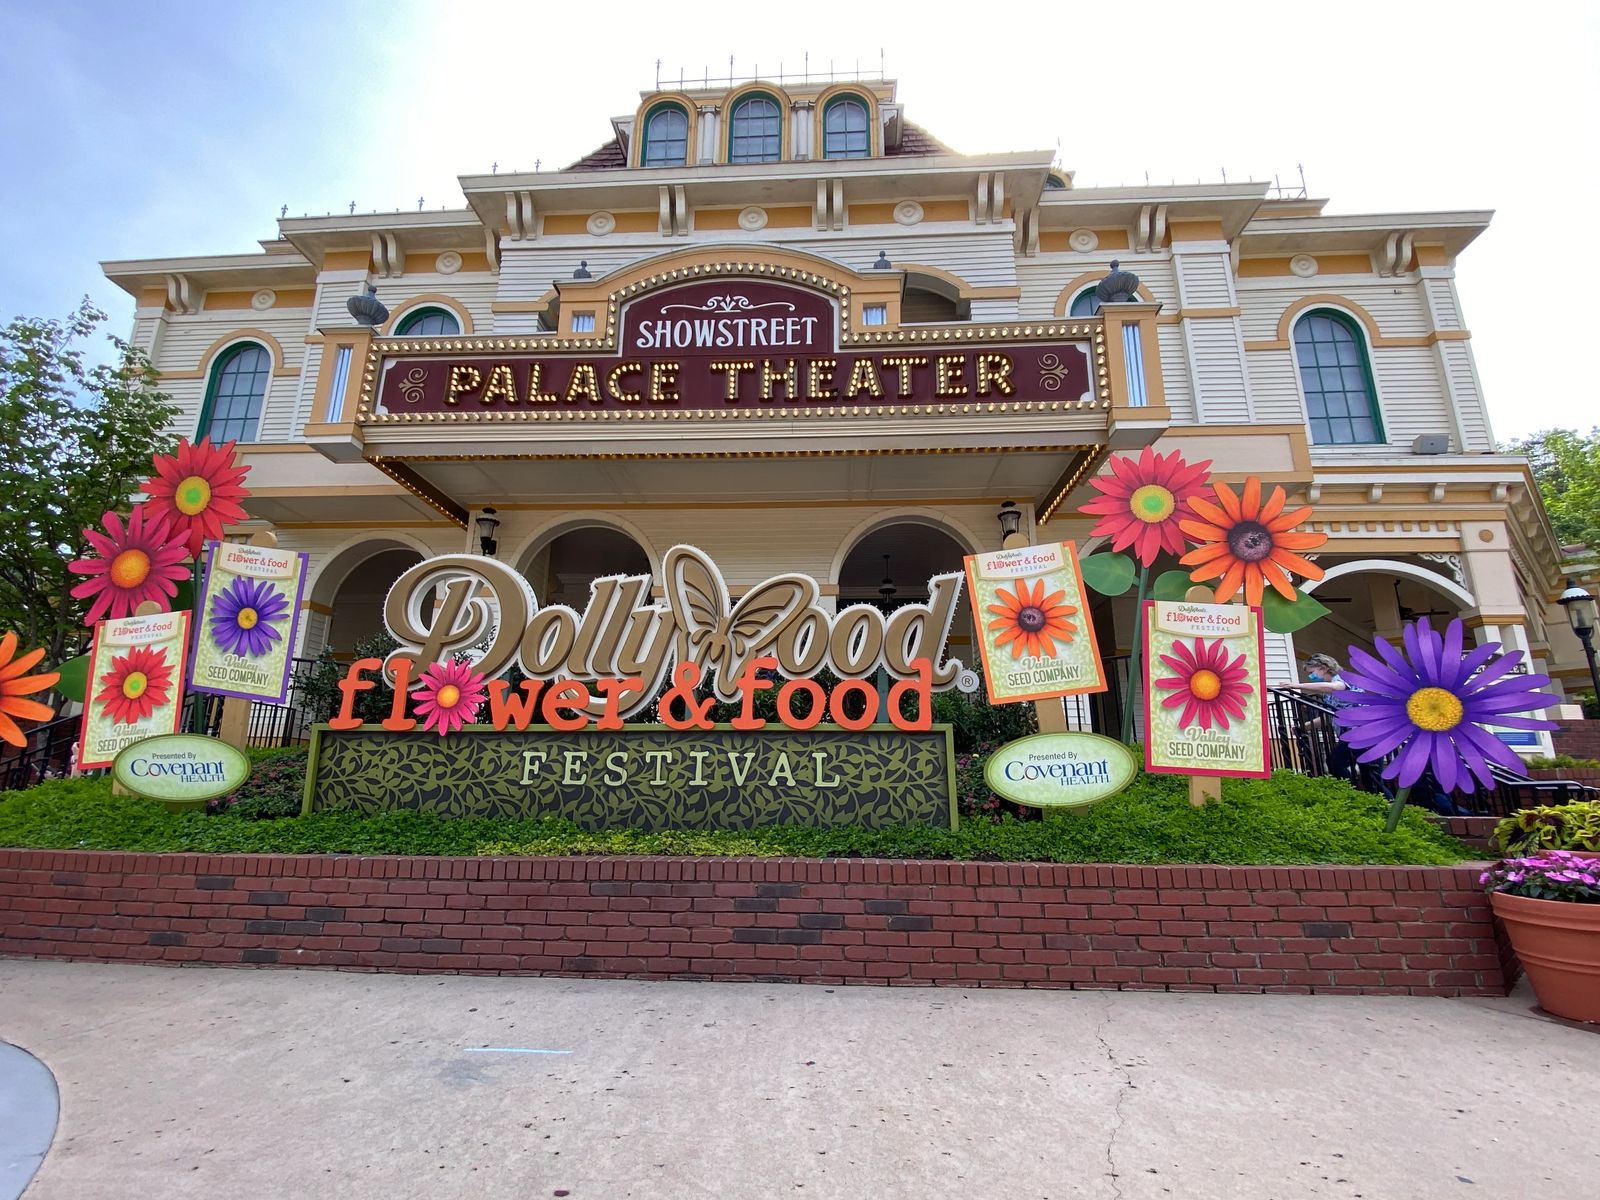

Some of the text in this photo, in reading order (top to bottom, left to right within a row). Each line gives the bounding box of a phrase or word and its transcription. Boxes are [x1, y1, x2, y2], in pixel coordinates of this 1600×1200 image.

[636, 316, 819, 349] SHOWSTREET
[445, 353, 1016, 405] PALACE THEATER
[260, 557, 267, 566] &
[267, 558, 289, 569] food
[1024, 556, 1031, 565] &
[1032, 552, 1056, 564] food
[1011, 564, 1048, 573] FESTIVAL
[152, 621, 173, 632] food
[1207, 614, 1215, 624] &
[1216, 614, 1241, 625] food
[224, 655, 258, 671] Valley
[1022, 656, 1063, 671] Valley
[208, 665, 269, 686] SEED COMPANY
[1008, 666, 1079, 686] SEED COMPANY
[658, 661, 717, 730] &
[730, 656, 933, 731] food
[114, 725, 148, 738] Valley
[1185, 727, 1230, 744] Valley
[97, 738, 117, 752] SEED
[1169, 742, 1245, 760] SEED COMPANY
[152, 752, 196, 760] Presented By
[1029, 751, 1078, 761] Presented By
[130, 758, 224, 777] Covenant
[519, 751, 841, 787] FESTIVAL
[1005, 759, 1108, 782] Covenant
[181, 774, 225, 783] HEALTH
[1061, 775, 1111, 786] HEALTH
